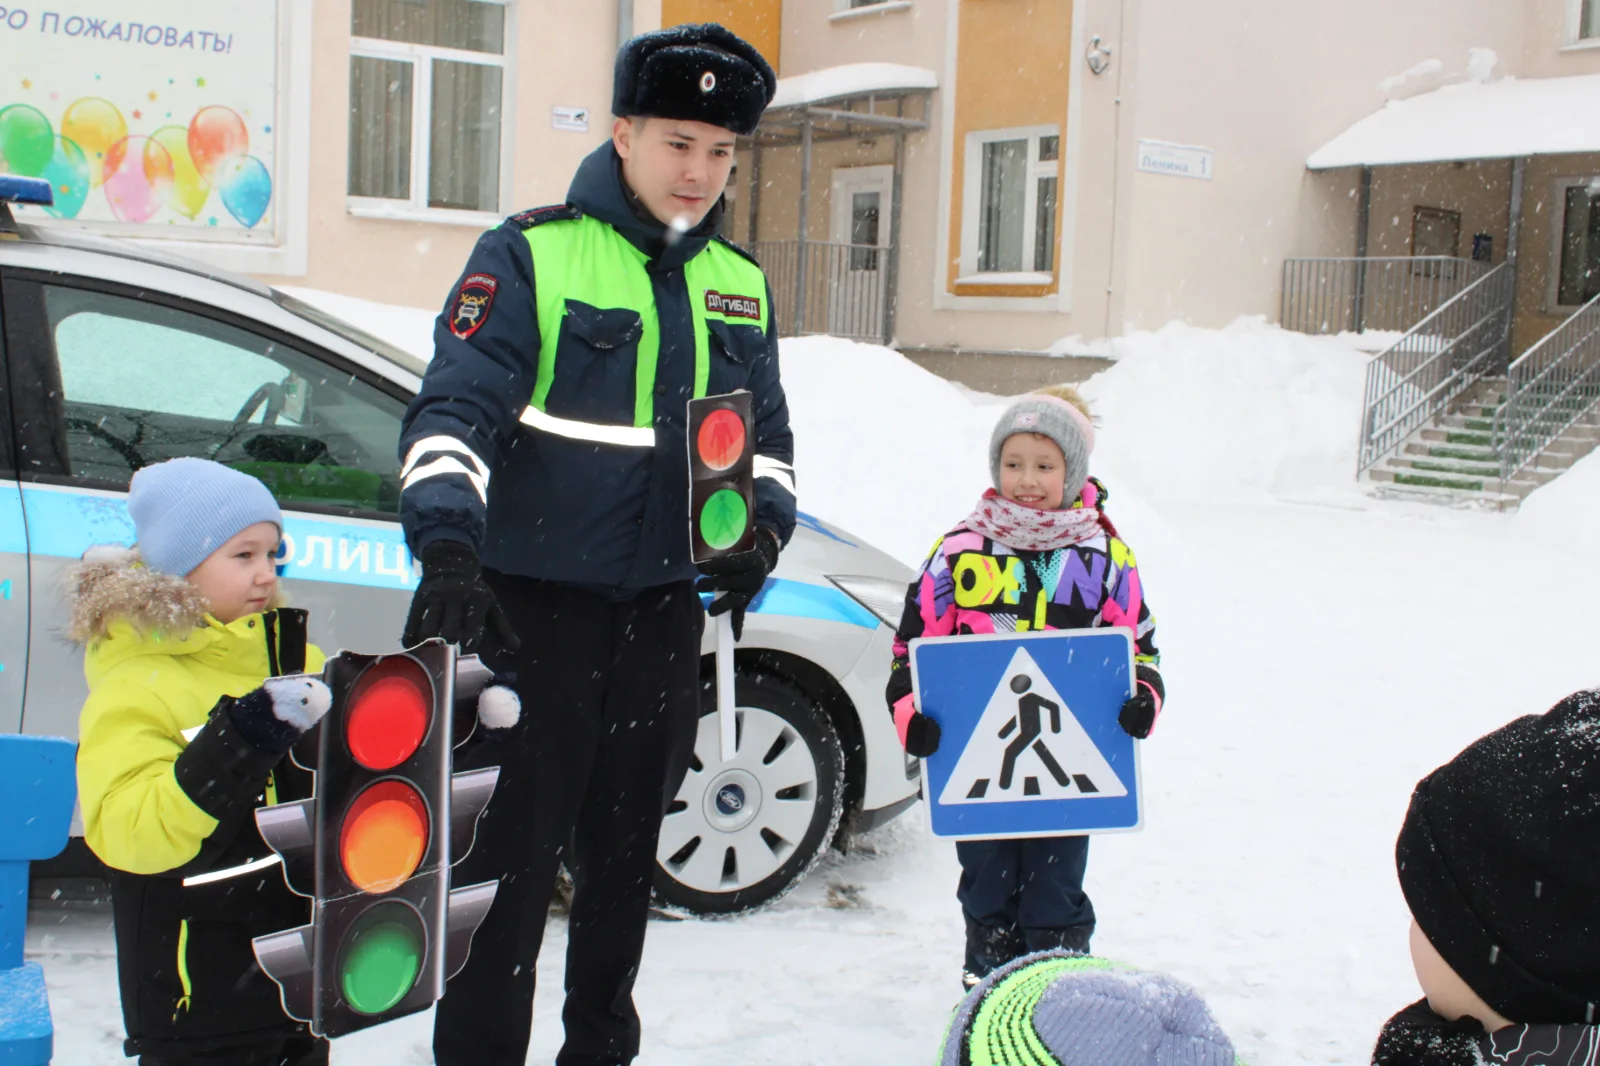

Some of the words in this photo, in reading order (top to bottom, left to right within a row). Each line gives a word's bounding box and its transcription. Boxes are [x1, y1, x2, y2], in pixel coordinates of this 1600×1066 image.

[40, 11, 234, 54] ПОЖАЛОВАТЬ!
[1142, 155, 1188, 172] Ленина
[1199, 155, 1207, 175] 1
[722, 298, 758, 316] ГИБДД
[275, 533, 423, 584] ОЛИЦ
